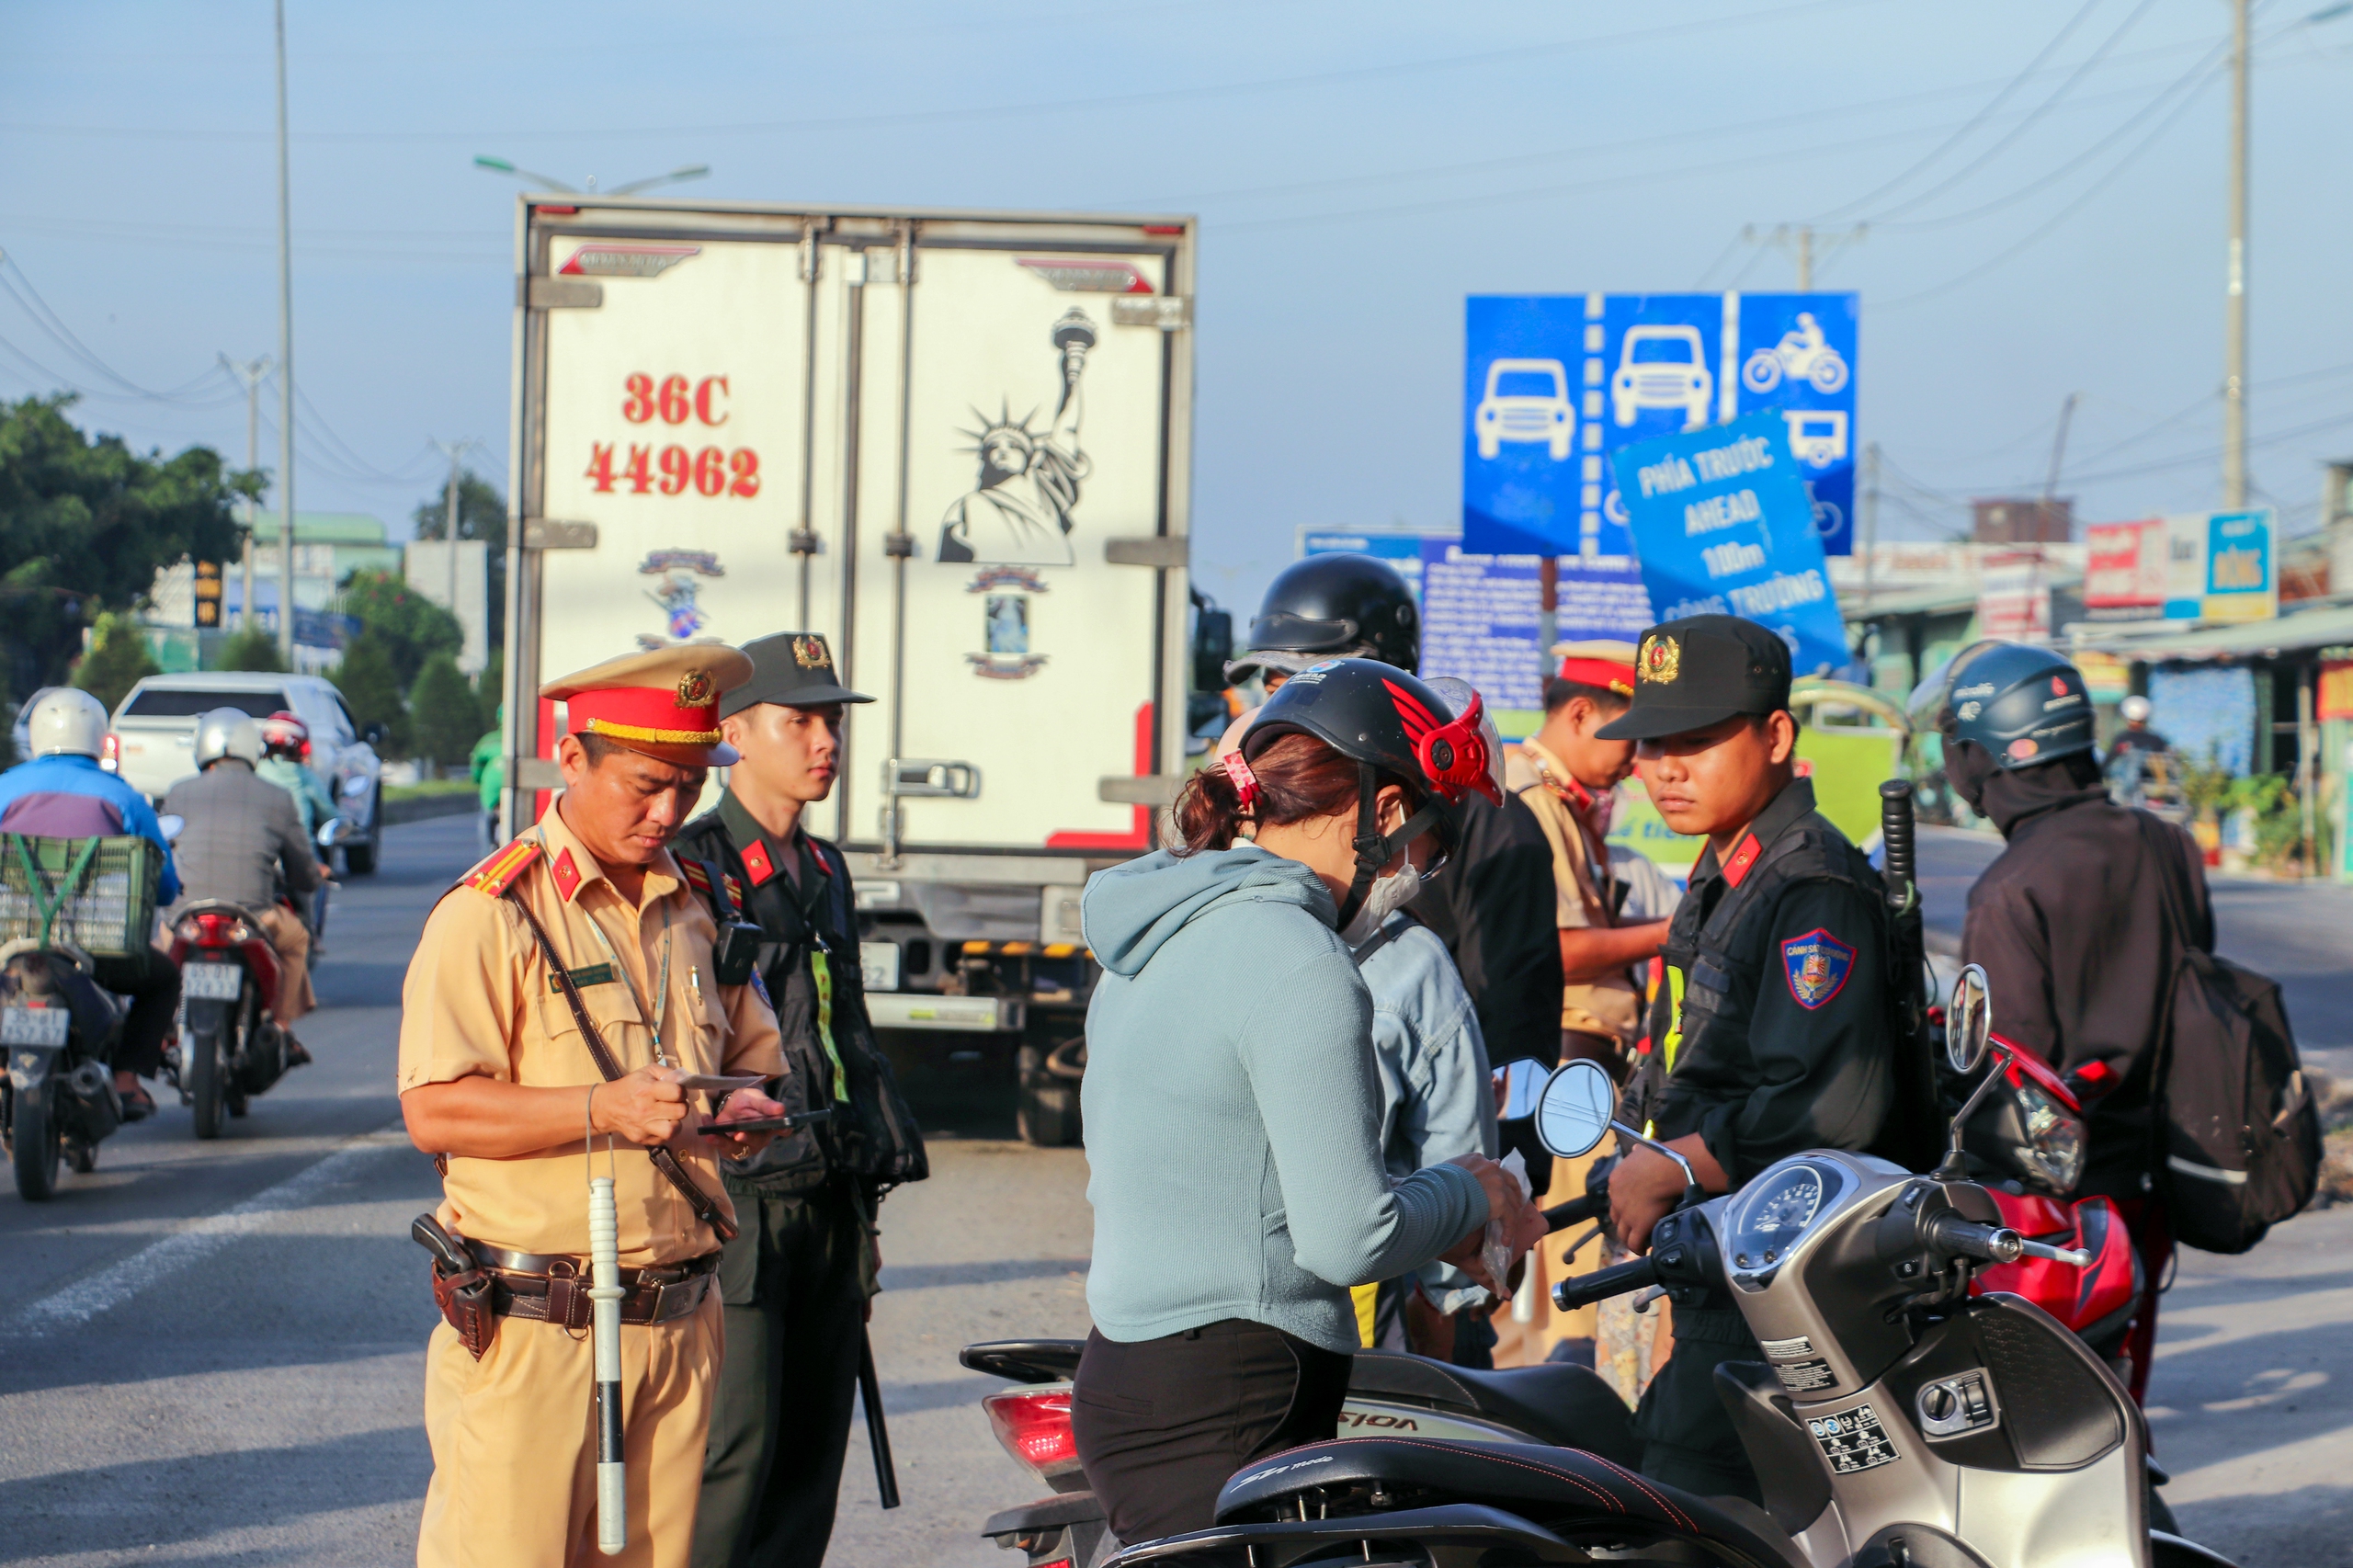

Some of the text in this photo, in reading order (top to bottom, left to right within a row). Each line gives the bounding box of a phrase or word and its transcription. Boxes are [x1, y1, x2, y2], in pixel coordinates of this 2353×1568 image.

[622, 372, 729, 426] 36C
[585, 440, 760, 498] 44962
[1637, 453, 1697, 499] PHÍA
[1684, 489, 1761, 538] AHEAD
[1700, 541, 1766, 580] 100m
[1788, 944, 1807, 956] CẢNH
[1809, 943, 1820, 953] SÁT
[1290, 1455, 1334, 1471] mode
